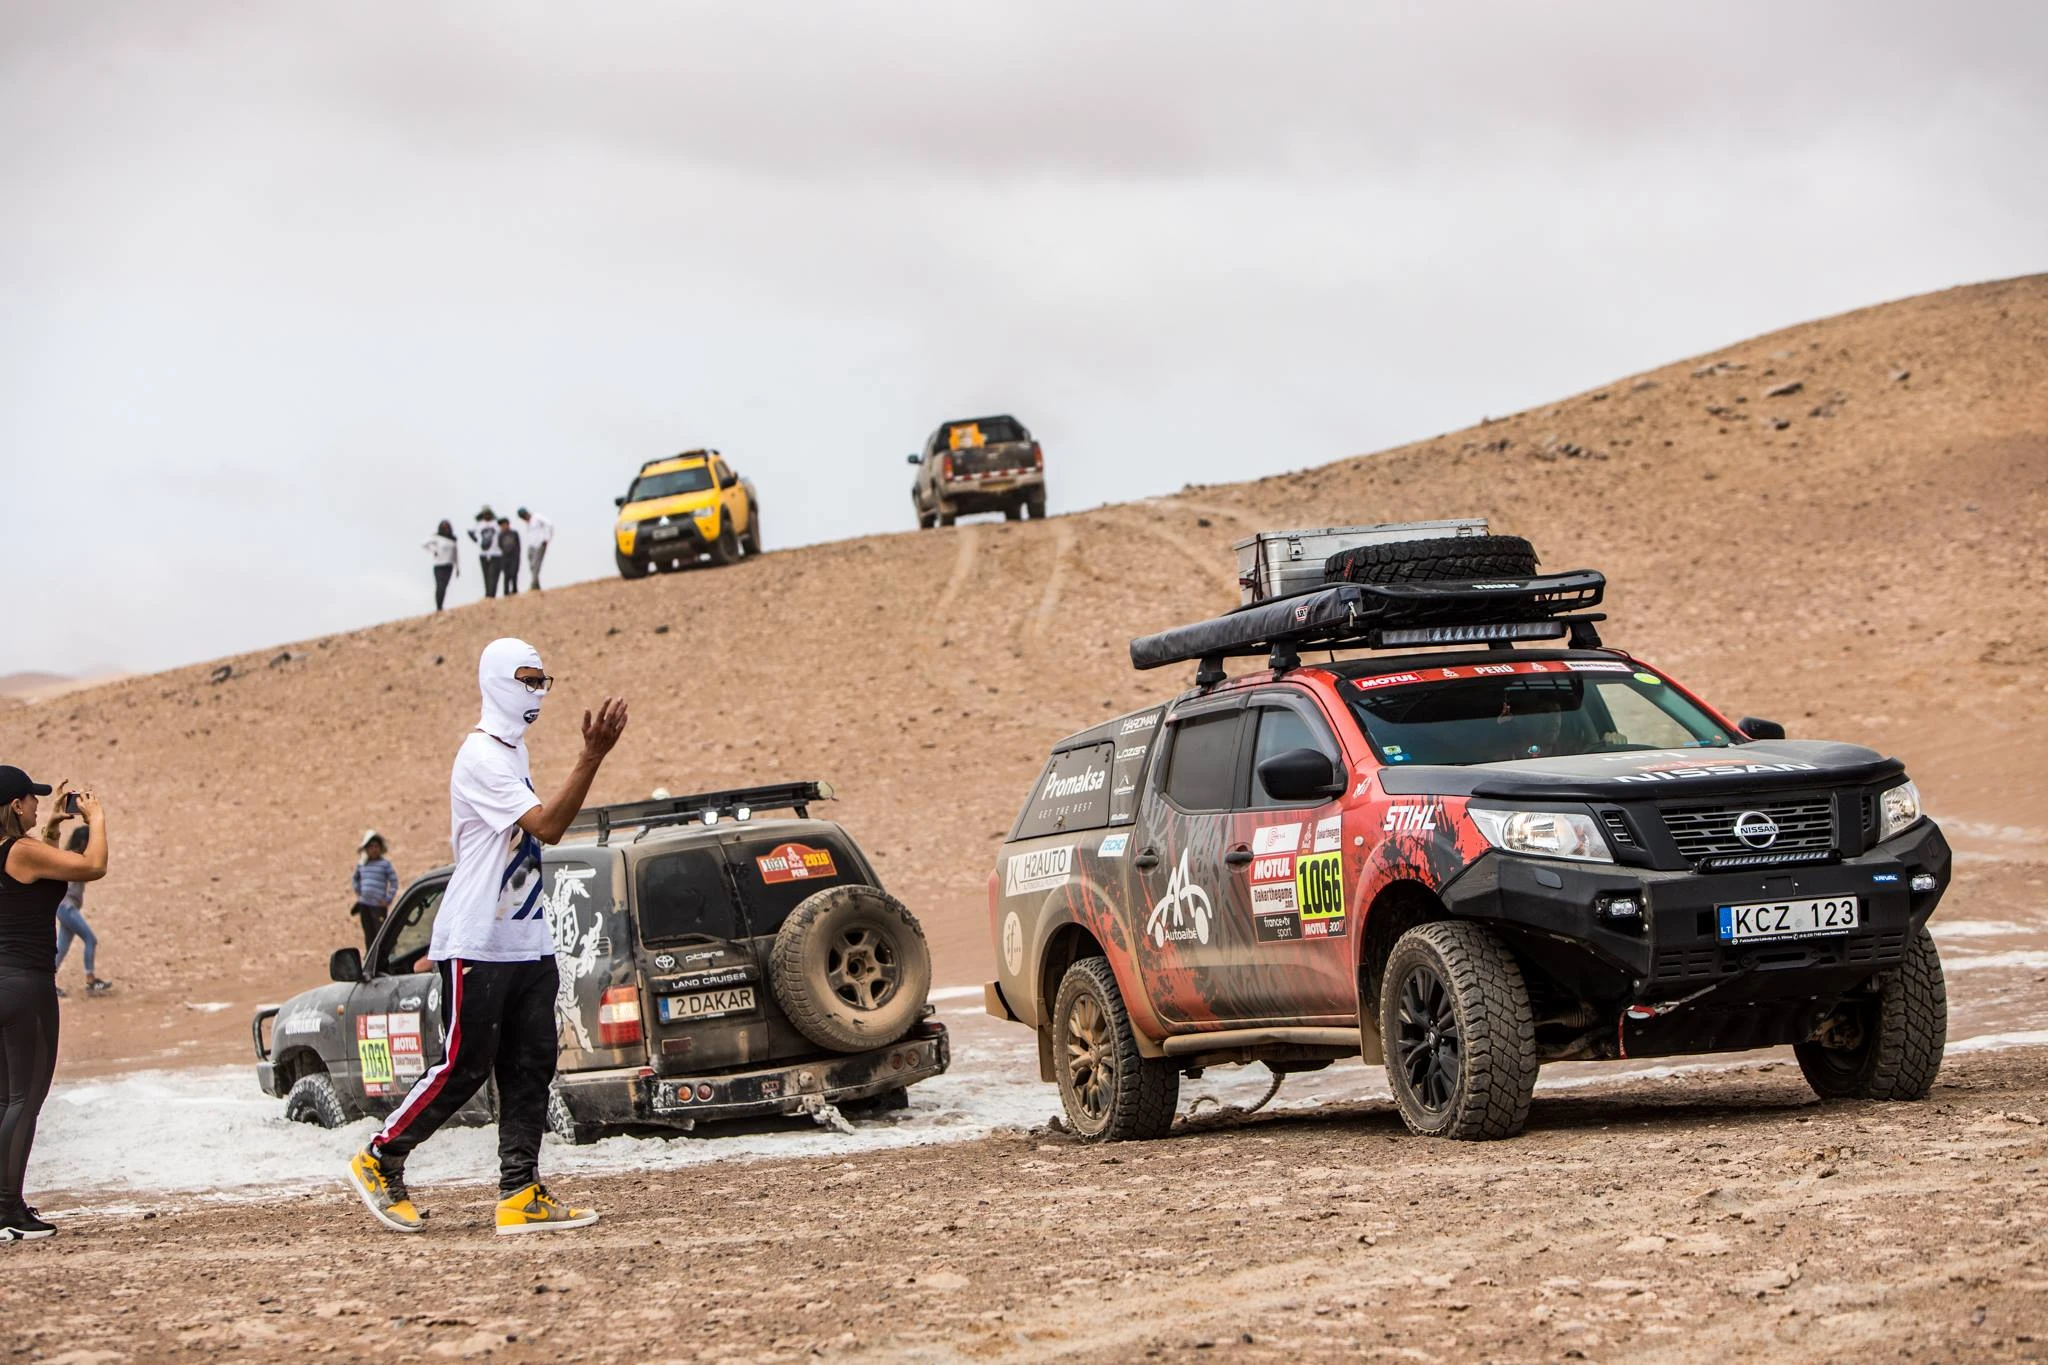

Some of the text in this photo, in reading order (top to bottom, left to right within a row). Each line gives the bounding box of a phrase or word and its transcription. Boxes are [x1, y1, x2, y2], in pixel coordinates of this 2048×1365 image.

[1362, 674, 1417, 688] MOTUL
[1614, 763, 1818, 783] NISSAN
[1041, 765, 1105, 800] Promaksa
[1038, 802, 1093, 820] GET THE BEST
[1383, 804, 1437, 831] STIHL
[1740, 825, 1776, 834] NISSAN
[763, 858, 787, 871] 1031
[1024, 849, 1066, 879] H2AUTO
[1253, 857, 1290, 879] MOTUL
[1299, 858, 1341, 914] 1066
[1736, 900, 1854, 934] KCZ 123
[1277, 927, 1293, 940] sport
[1304, 920, 1345, 935] MOTUL 300V
[1720, 926, 1731, 934] LT
[672, 972, 747, 989] LAND CRUISER
[393, 1036, 419, 1051] MOTUL
[361, 1043, 390, 1078] 1031
